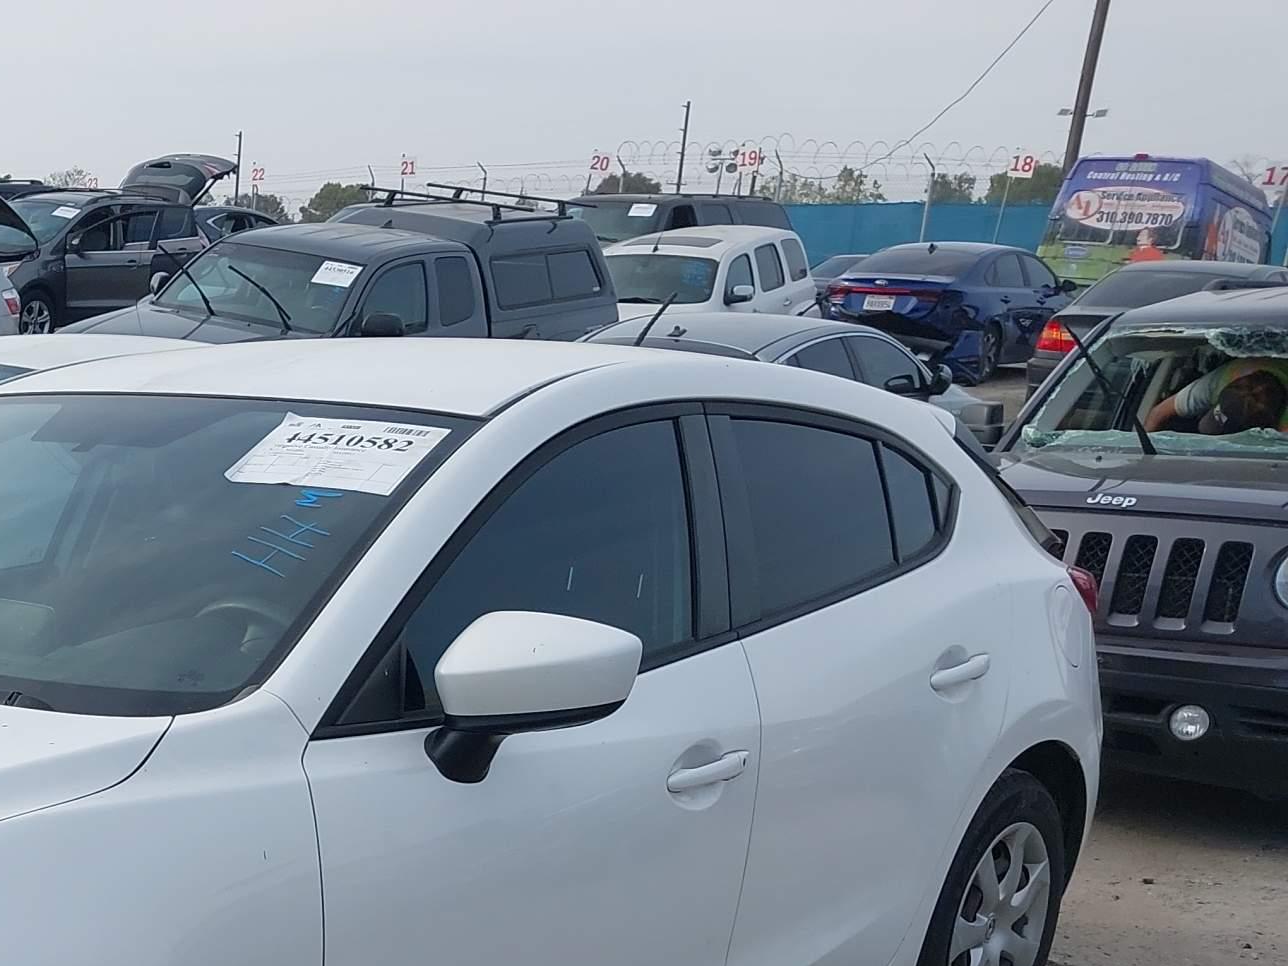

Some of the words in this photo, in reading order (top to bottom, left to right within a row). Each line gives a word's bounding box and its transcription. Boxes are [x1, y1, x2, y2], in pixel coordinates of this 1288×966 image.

[590, 155, 610, 171] 20
[738, 150, 758, 167] 19
[1009, 155, 1034, 173] 18
[252, 168, 265, 181] 22
[401, 161, 416, 175] 21
[1096, 210, 1173, 226] 310.390.7870
[287, 431, 415, 452] 44510582
[1086, 493, 1137, 508] Jeep
